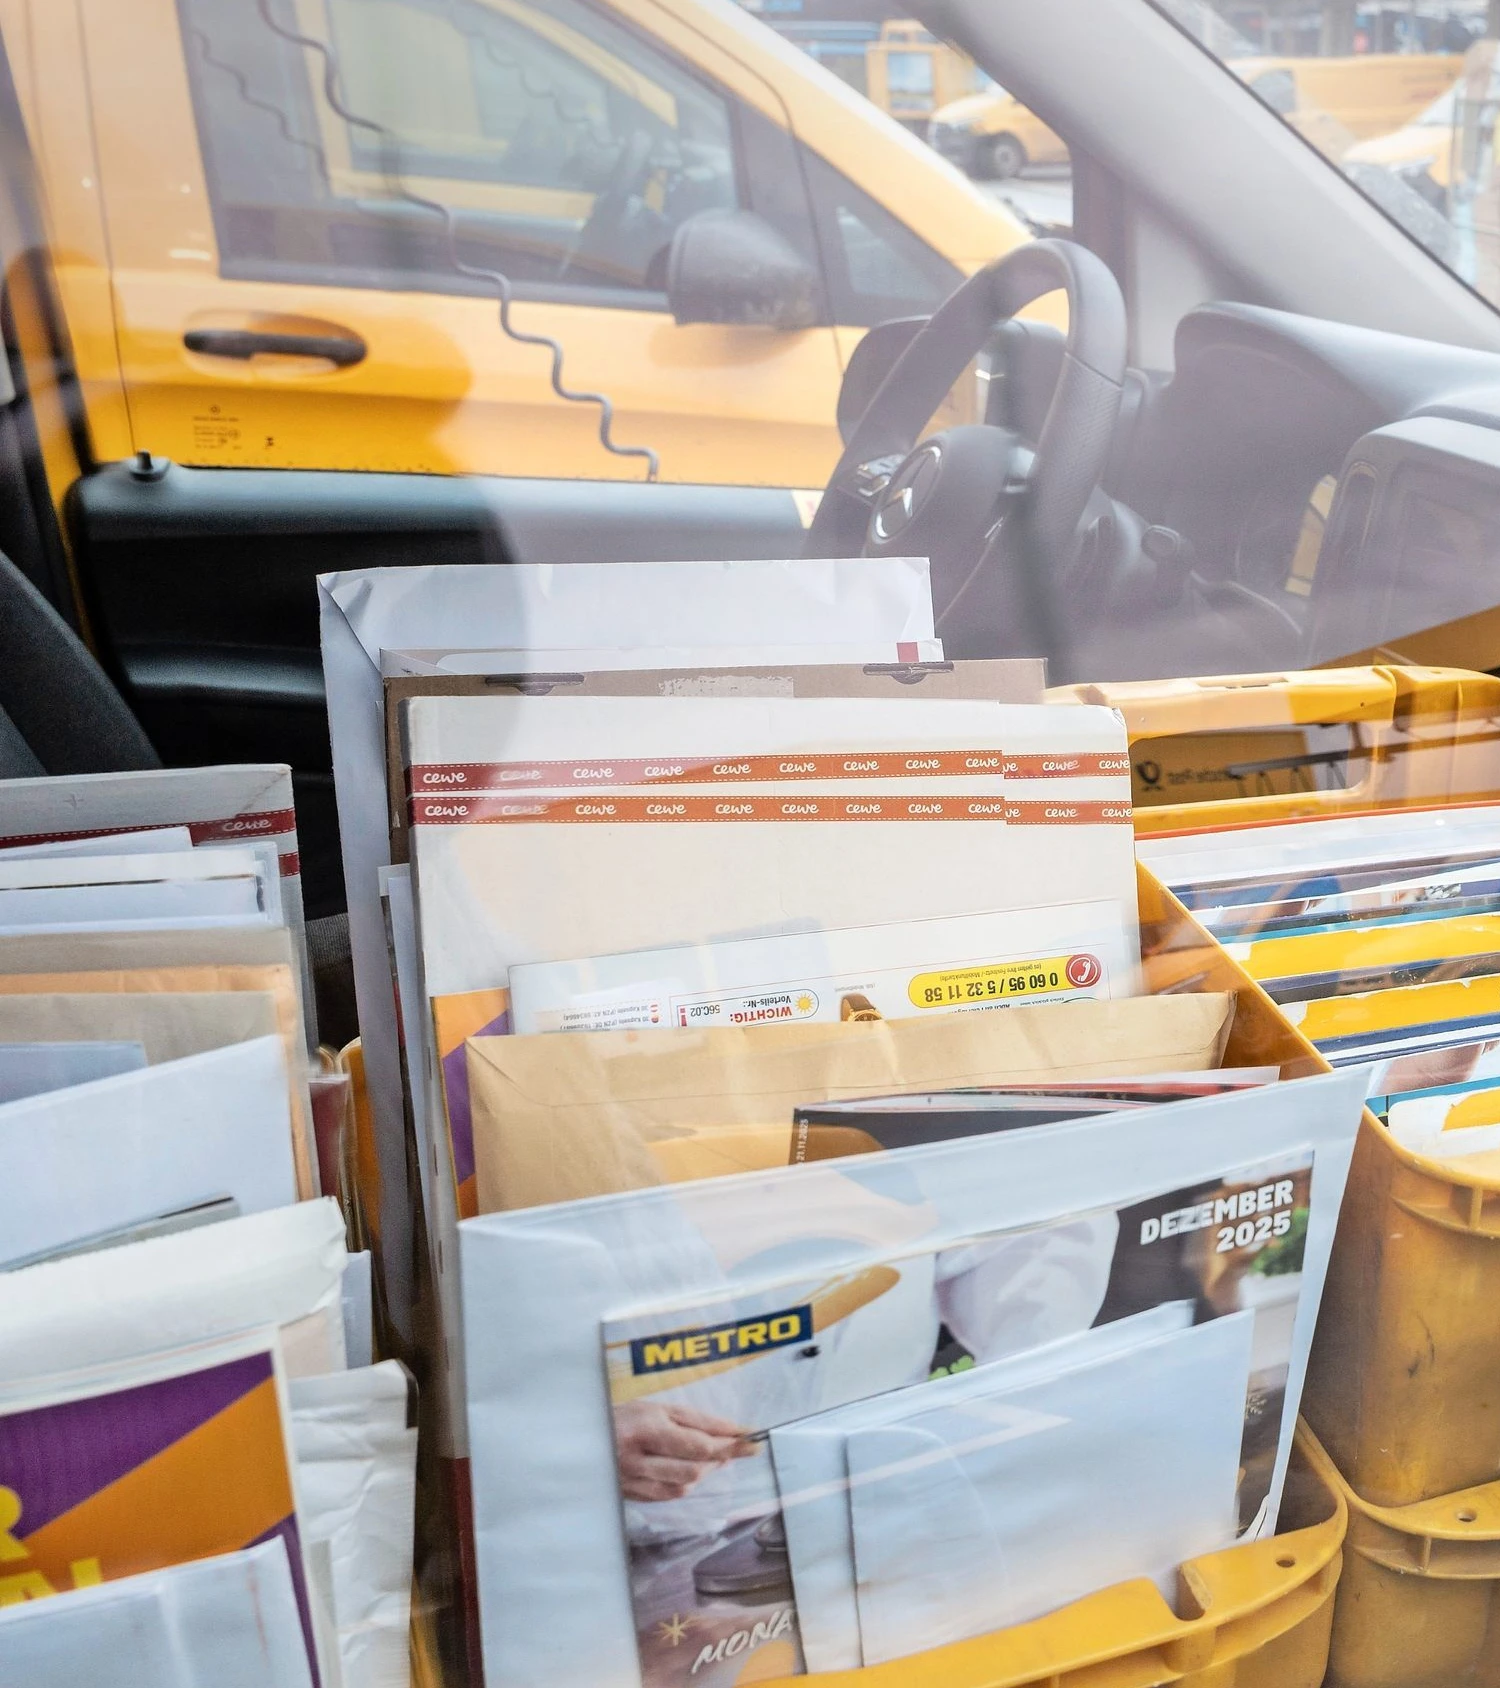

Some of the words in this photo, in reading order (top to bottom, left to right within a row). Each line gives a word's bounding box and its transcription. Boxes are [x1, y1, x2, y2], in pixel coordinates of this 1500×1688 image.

[423, 771, 467, 784] cewe
[573, 766, 614, 778] cewe
[644, 764, 685, 777] cewe
[713, 763, 752, 775] cewe
[779, 761, 816, 773] cewe
[843, 759, 879, 771] cewe
[905, 758, 941, 770] cewe
[965, 756, 1000, 768] cewe
[1099, 759, 1130, 769] cewe
[425, 804, 469, 817] cewe
[575, 803, 617, 815] cewe
[646, 803, 687, 815] cewe
[715, 803, 754, 815] cewe
[781, 803, 819, 815] cewe
[845, 803, 882, 814] cewe
[908, 803, 943, 814] cewe
[968, 803, 1002, 814] cewe
[1045, 807, 1077, 818] cewe
[1102, 807, 1133, 818] cewe
[222, 819, 272, 832] cewe
[998, 978, 1005, 992] /
[1008, 976, 1025, 991] 95
[1029, 973, 1045, 988] 60
[1049, 971, 1058, 986] 0
[924, 986, 943, 1002] 58
[947, 984, 961, 999] 11
[966, 981, 984, 996] 32
[987, 979, 995, 994] 5
[742, 994, 791, 1009] Vorteils-Nr.:
[689, 1003, 720, 1016] 56C.02
[729, 1005, 792, 1023] WICHTIG:
[1140, 1180, 1293, 1245] DEZEMBER
[1216, 1210, 1291, 1253] 2025
[643, 1314, 801, 1367] METRO
